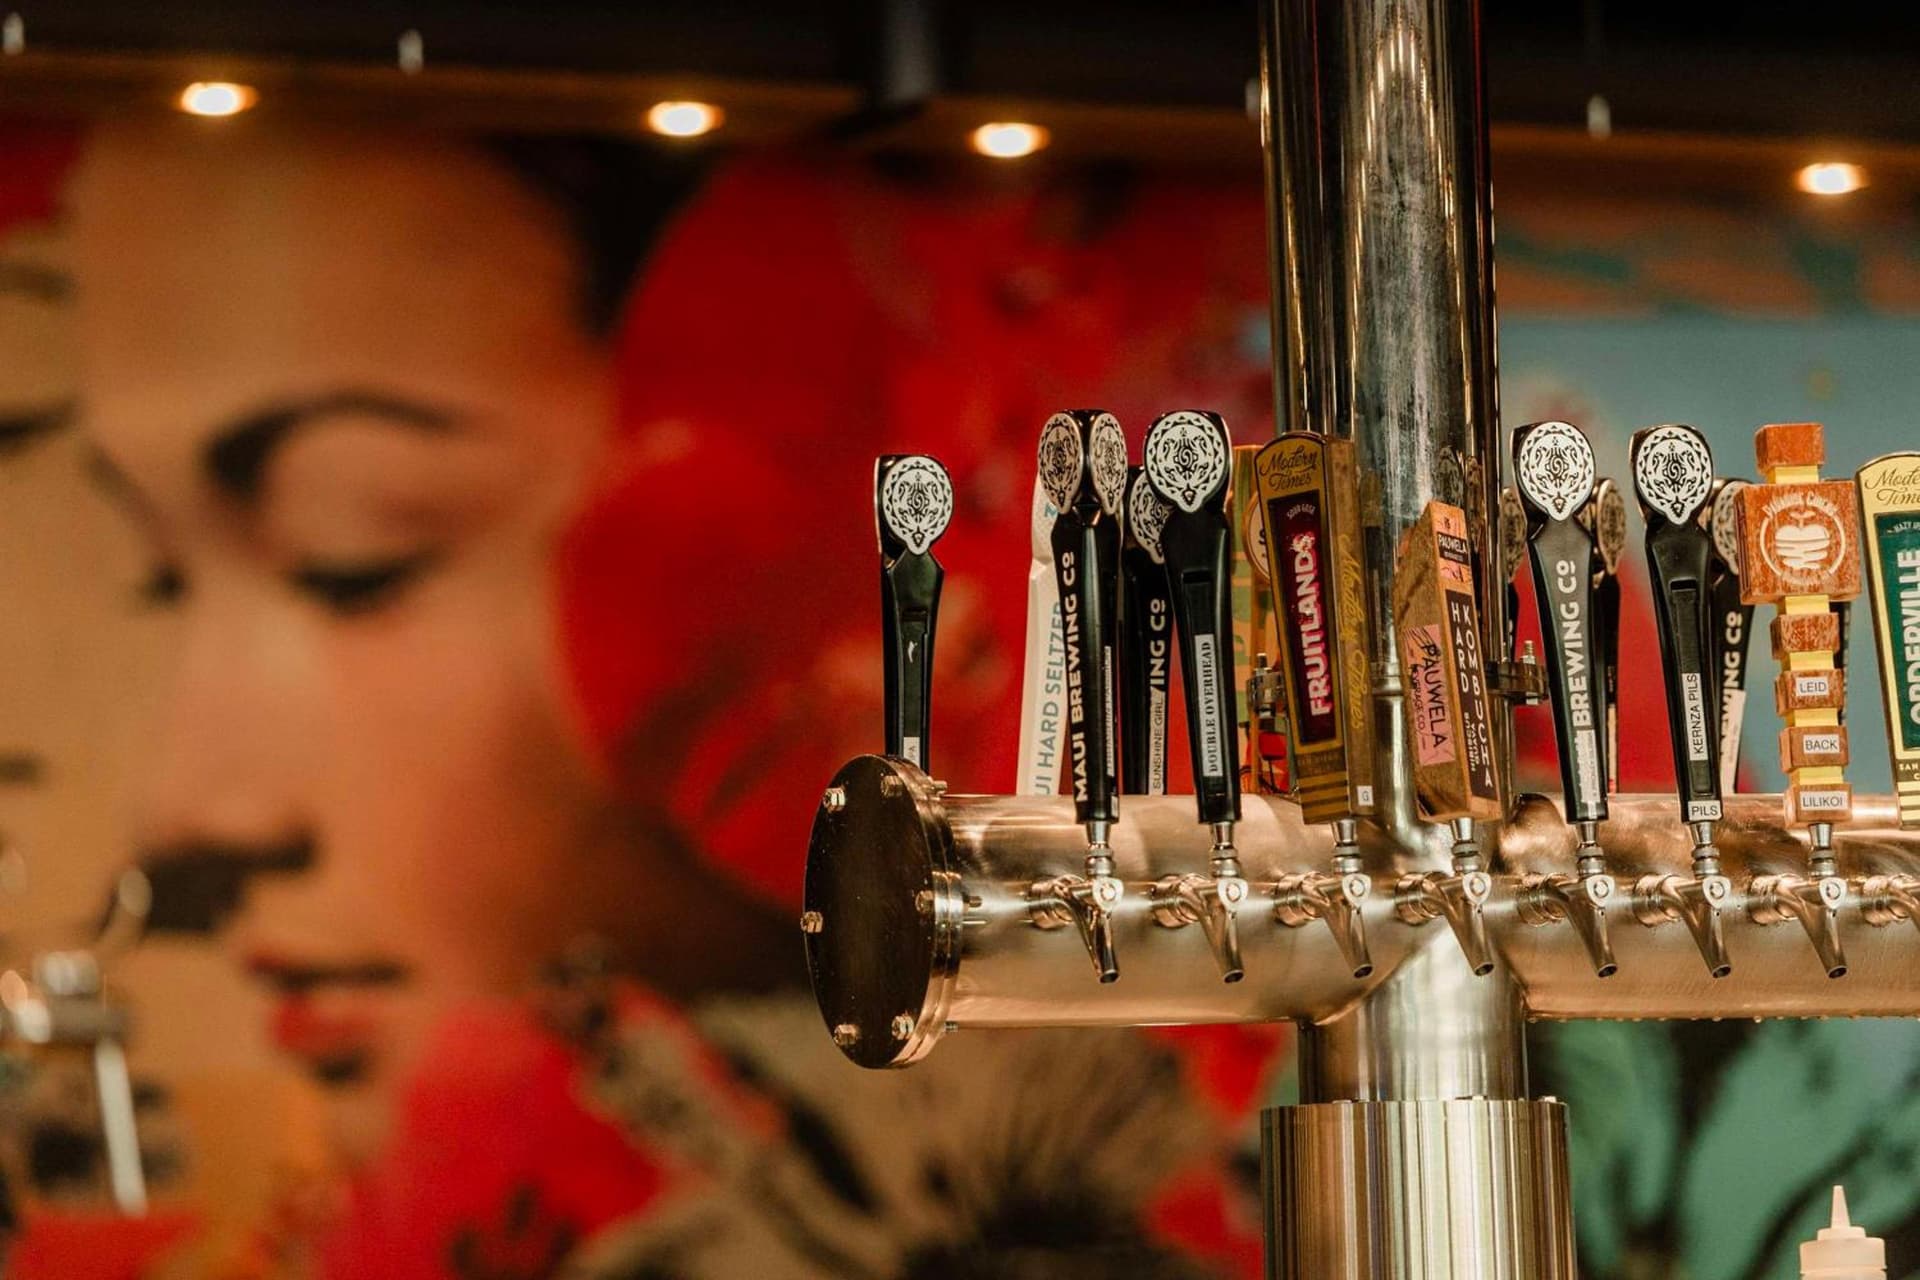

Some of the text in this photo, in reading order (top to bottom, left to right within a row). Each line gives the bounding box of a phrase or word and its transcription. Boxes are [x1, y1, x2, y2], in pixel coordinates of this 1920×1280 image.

[1065, 593, 1084, 725] BREWING
[1289, 538, 1333, 717] FRUITLANDS
[1452, 602, 1470, 693] HARD
[1560, 601, 1592, 727] BREWING
[1201, 641, 1219, 774] DOUBLE OVERHEAD
[1421, 643, 1447, 748] PAUWELA
[1463, 604, 1494, 788] KOMBUCHA
[1686, 673, 1704, 756] KERNZA PILS
[1800, 681, 1827, 694] LEID
[1037, 702, 1060, 769] HARD
[1072, 732, 1088, 802] MAUI
[1153, 727, 1164, 790] SUNSHINE
[1805, 739, 1838, 751] BACK
[1691, 804, 1719, 817] PILS
[1802, 795, 1844, 808] LILIKOI
